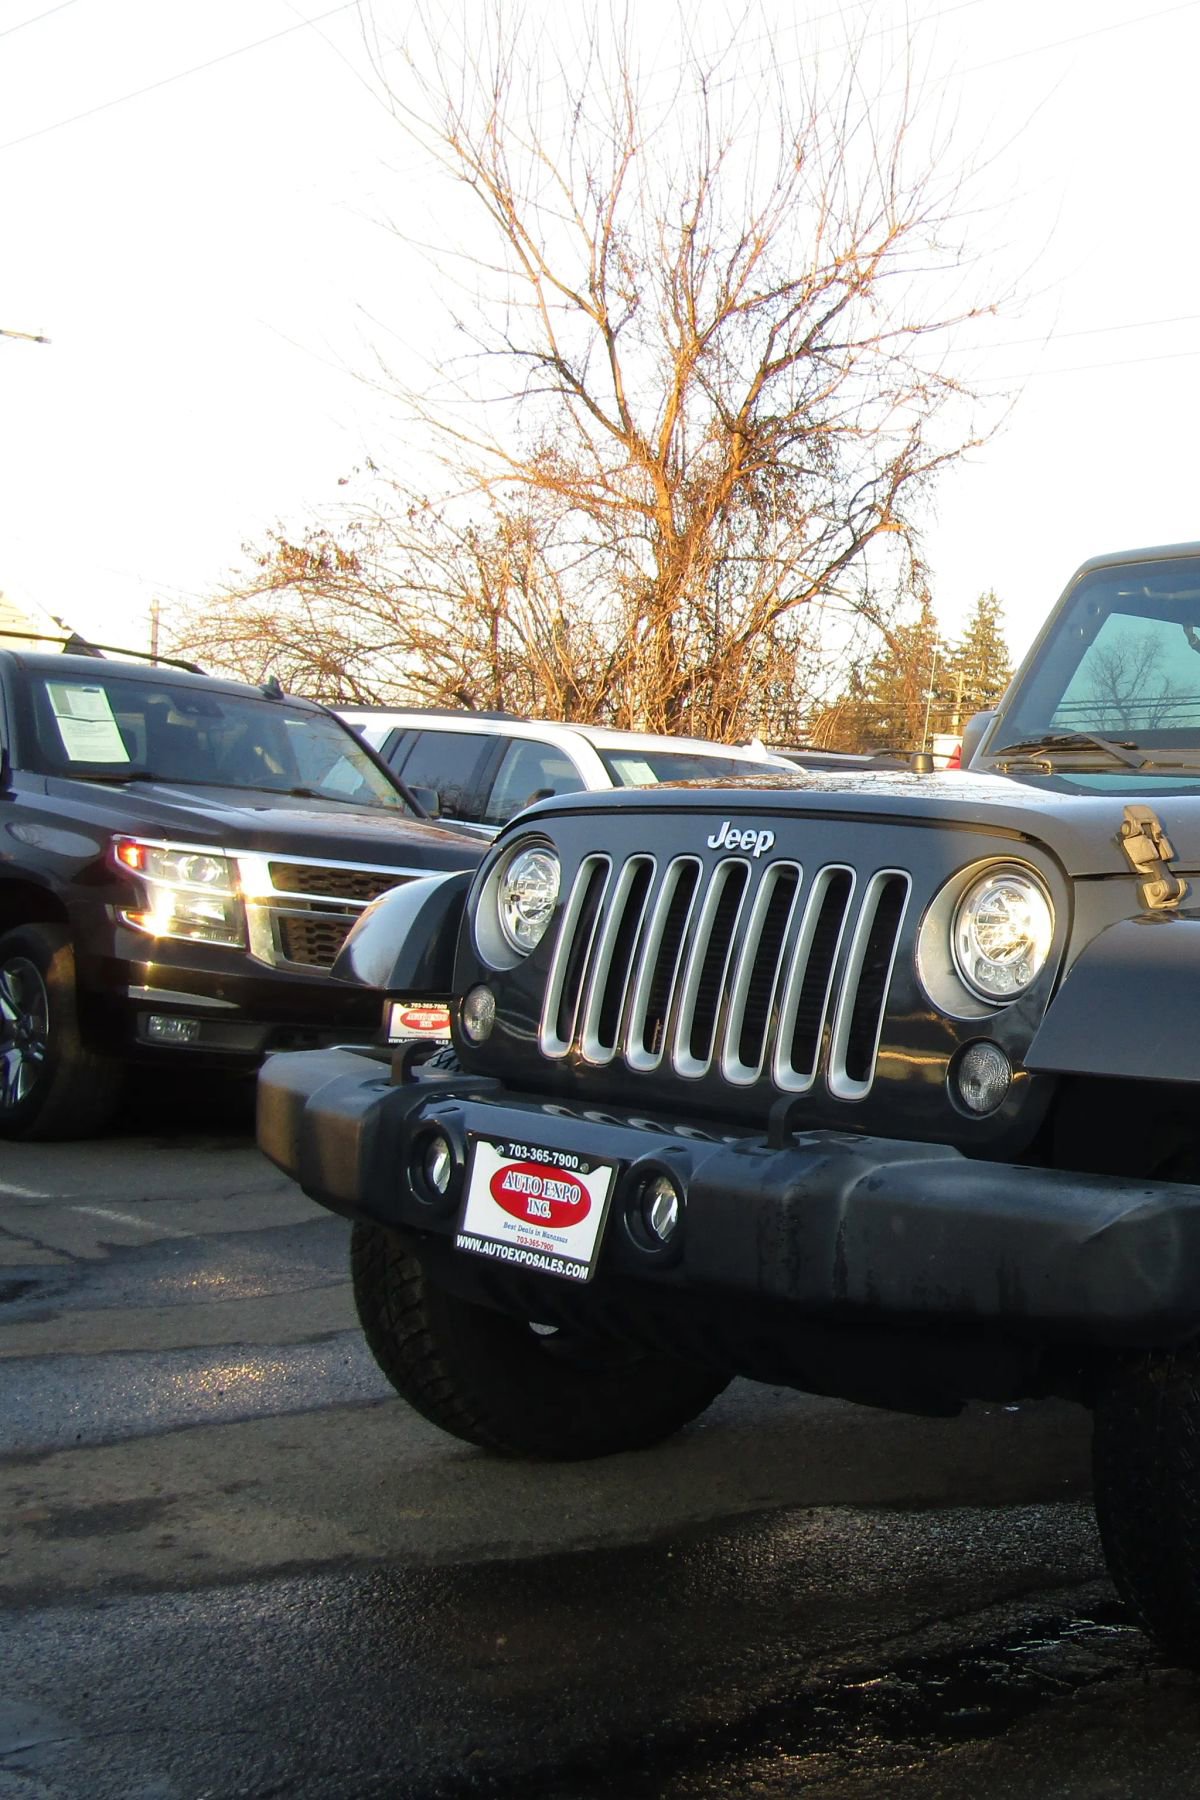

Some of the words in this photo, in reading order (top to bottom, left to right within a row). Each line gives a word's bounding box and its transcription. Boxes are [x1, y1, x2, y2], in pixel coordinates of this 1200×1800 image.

[707, 821, 775, 858] Jeep
[509, 1143, 579, 1169] 703-365-7900
[503, 1171, 542, 1195] AUTO
[542, 1176, 581, 1204] EXPO
[456, 1235, 589, 1280] WWW.AUTOEXPOSALES.COM
[515, 1236, 554, 1251] 703-365-7900
